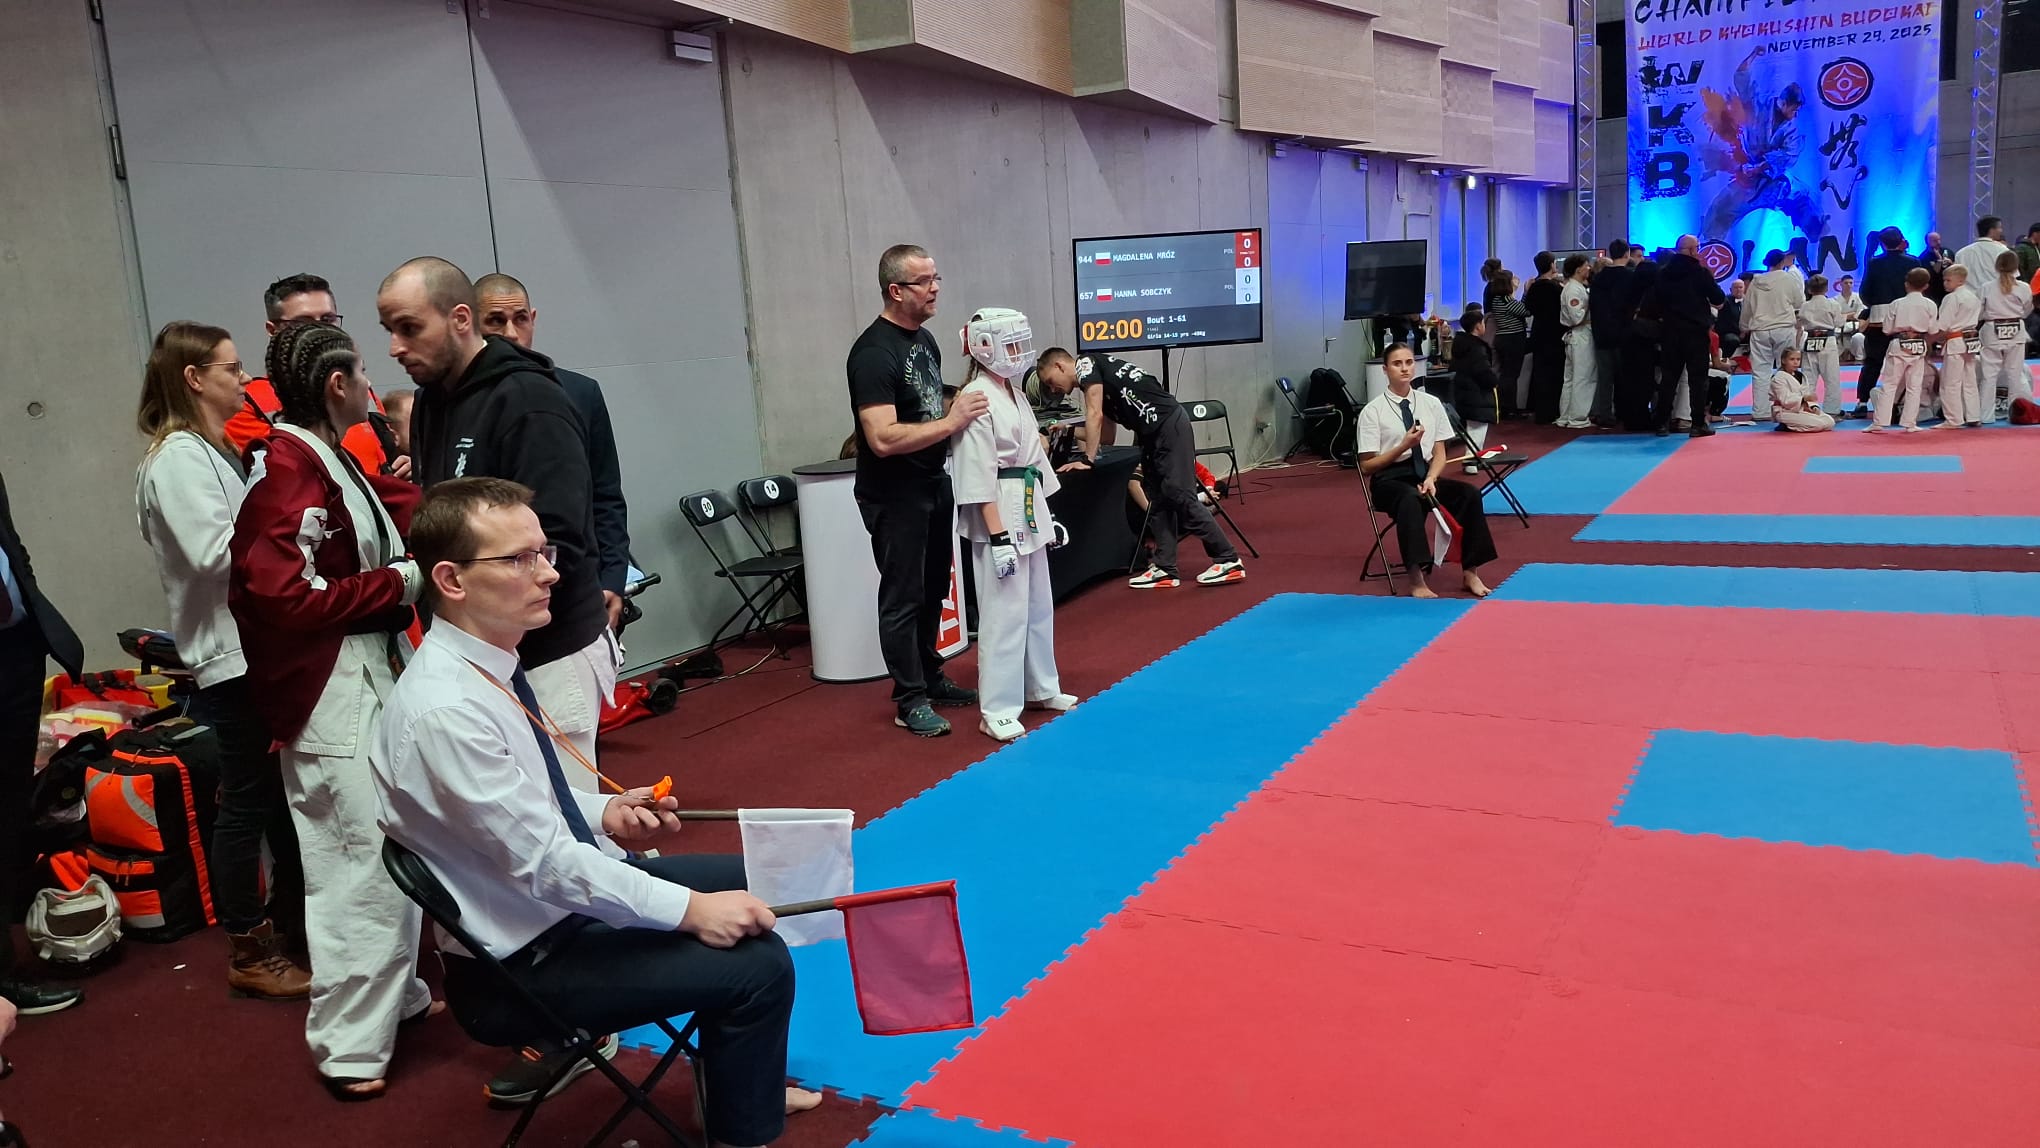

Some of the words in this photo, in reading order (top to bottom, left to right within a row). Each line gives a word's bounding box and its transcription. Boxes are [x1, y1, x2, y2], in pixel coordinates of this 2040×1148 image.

[1638, 29, 1713, 51] WORLD
[1718, 13, 1833, 40] KYOKUSHIN
[1840, 2, 1935, 27] BUDOKAI
[1767, 33, 1857, 53] NOVEMBER
[1862, 29, 1886, 43] 29,
[1889, 24, 1932, 40] 2025
[1244, 238, 1251, 249] 0
[1078, 255, 1093, 264] 944
[1112, 252, 1154, 262] MAGDALENA
[1156, 250, 1176, 259] MRÓZ
[1244, 257, 1251, 267] 0
[1245, 275, 1251, 284] 0
[1079, 292, 1094, 300] 657
[1114, 289, 1137, 298] HANNA
[1140, 287, 1172, 297] SOBCZYK
[1245, 293, 1251, 302] 0
[1146, 316, 1165, 324] Bout
[1168, 314, 1187, 323] 1-61
[1082, 319, 1143, 341] 02:00
[766, 483, 777, 495] 14
[703, 502, 712, 513] 30
